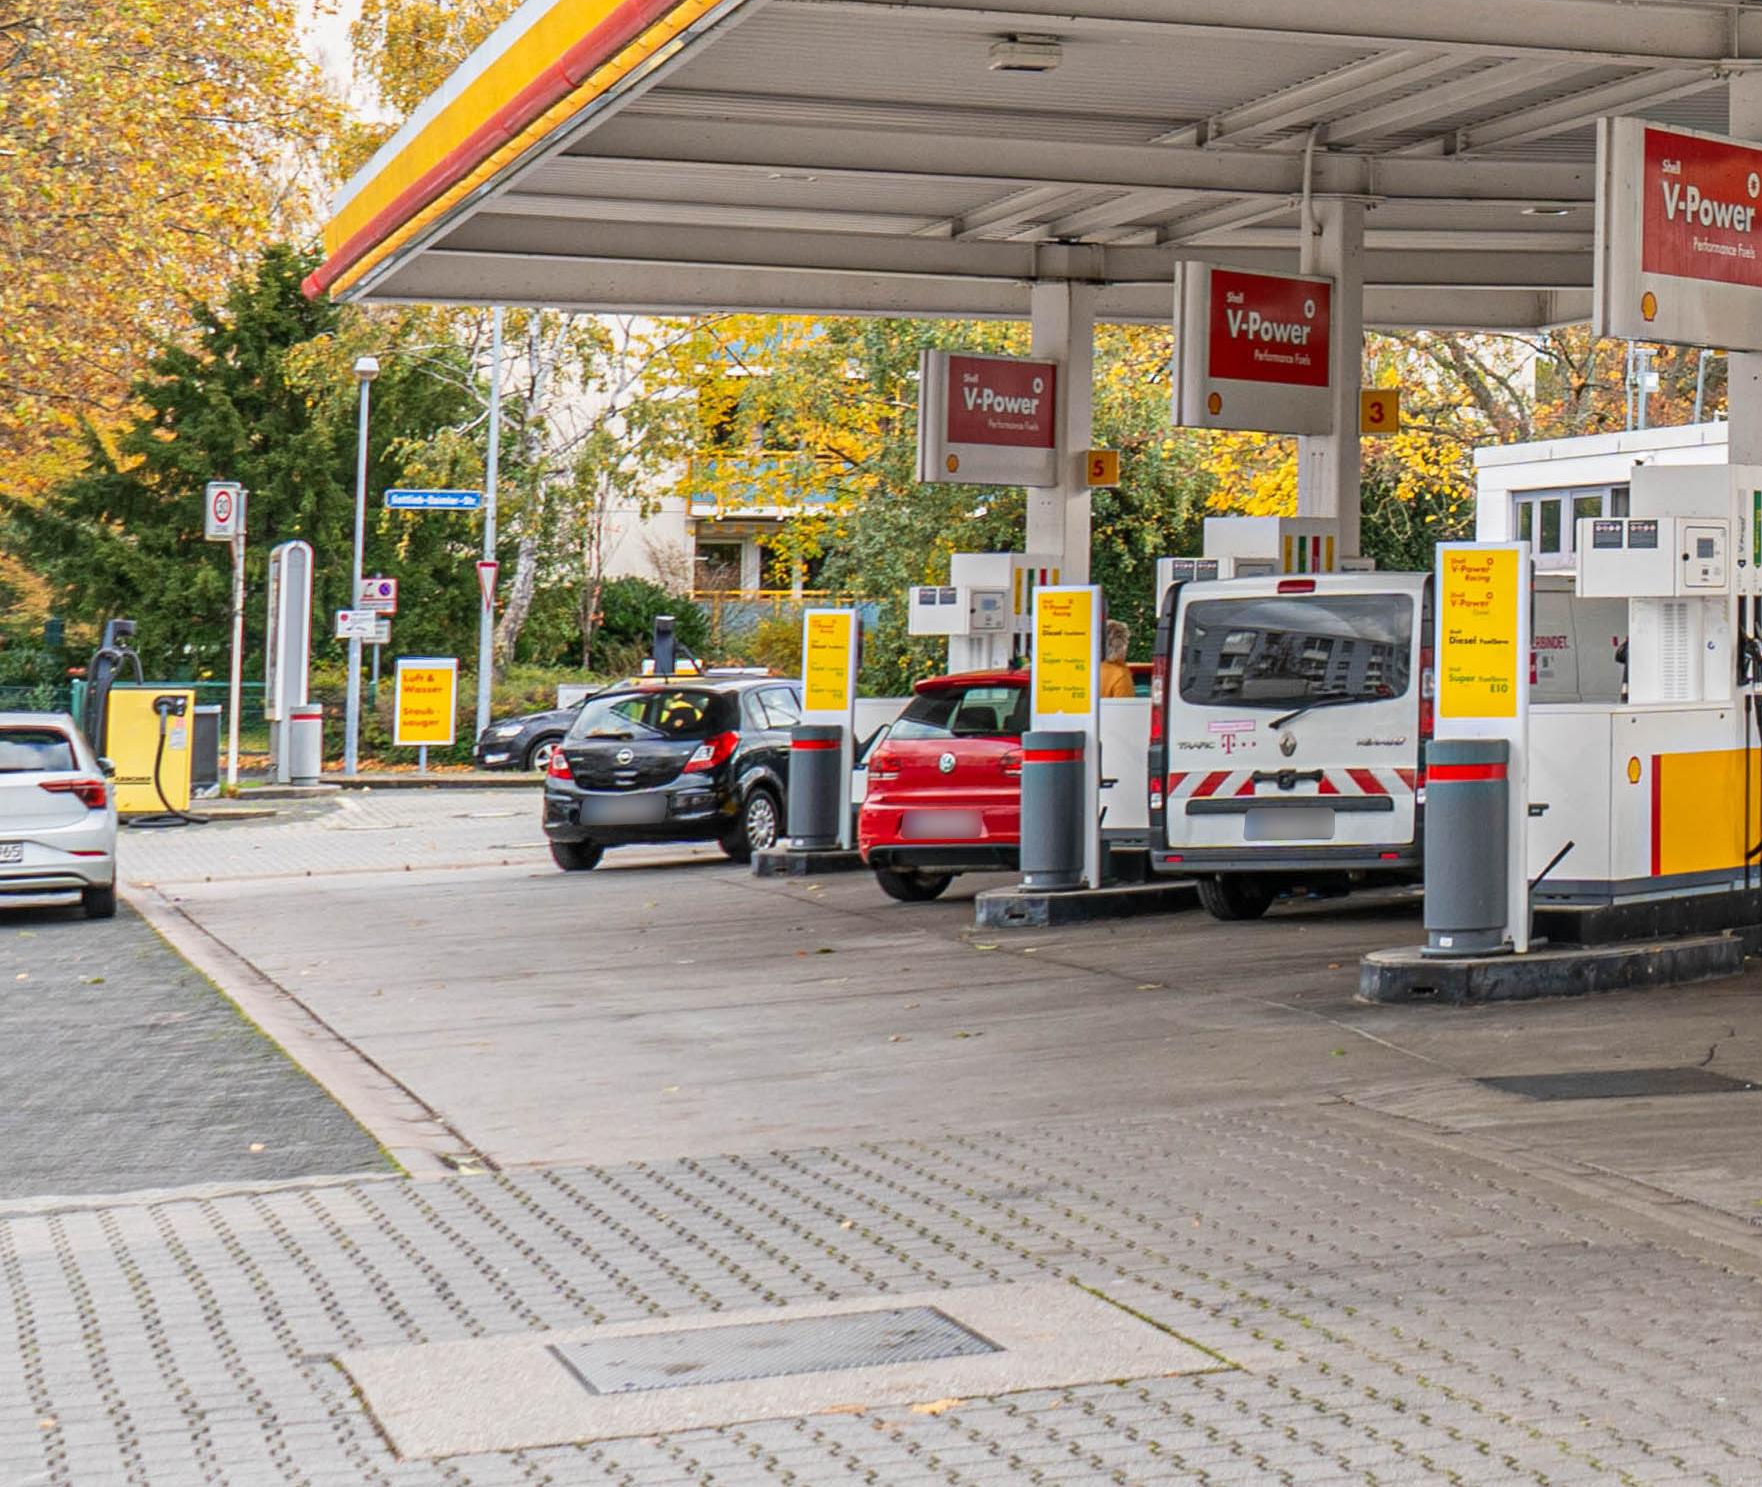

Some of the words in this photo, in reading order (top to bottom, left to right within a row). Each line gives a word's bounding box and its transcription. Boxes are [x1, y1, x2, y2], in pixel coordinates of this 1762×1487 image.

[1662, 159, 1681, 175] Shell
[1662, 181, 1755, 232] V-Power
[1694, 237, 1737, 257] Performance
[1738, 242, 1756, 259] Fuels
[1227, 309, 1311, 345] V-Power
[1254, 349, 1294, 364] Performance
[963, 387, 1039, 415] V-Power
[1369, 401, 1385, 424] 3
[1451, 564, 1490, 574] V-Power
[1465, 574, 1490, 583] Racing
[1450, 599, 1490, 608] V-Power
[1448, 635, 1477, 645] Diesel
[1448, 674, 1475, 684] Super
[1489, 684, 1509, 693] E10
